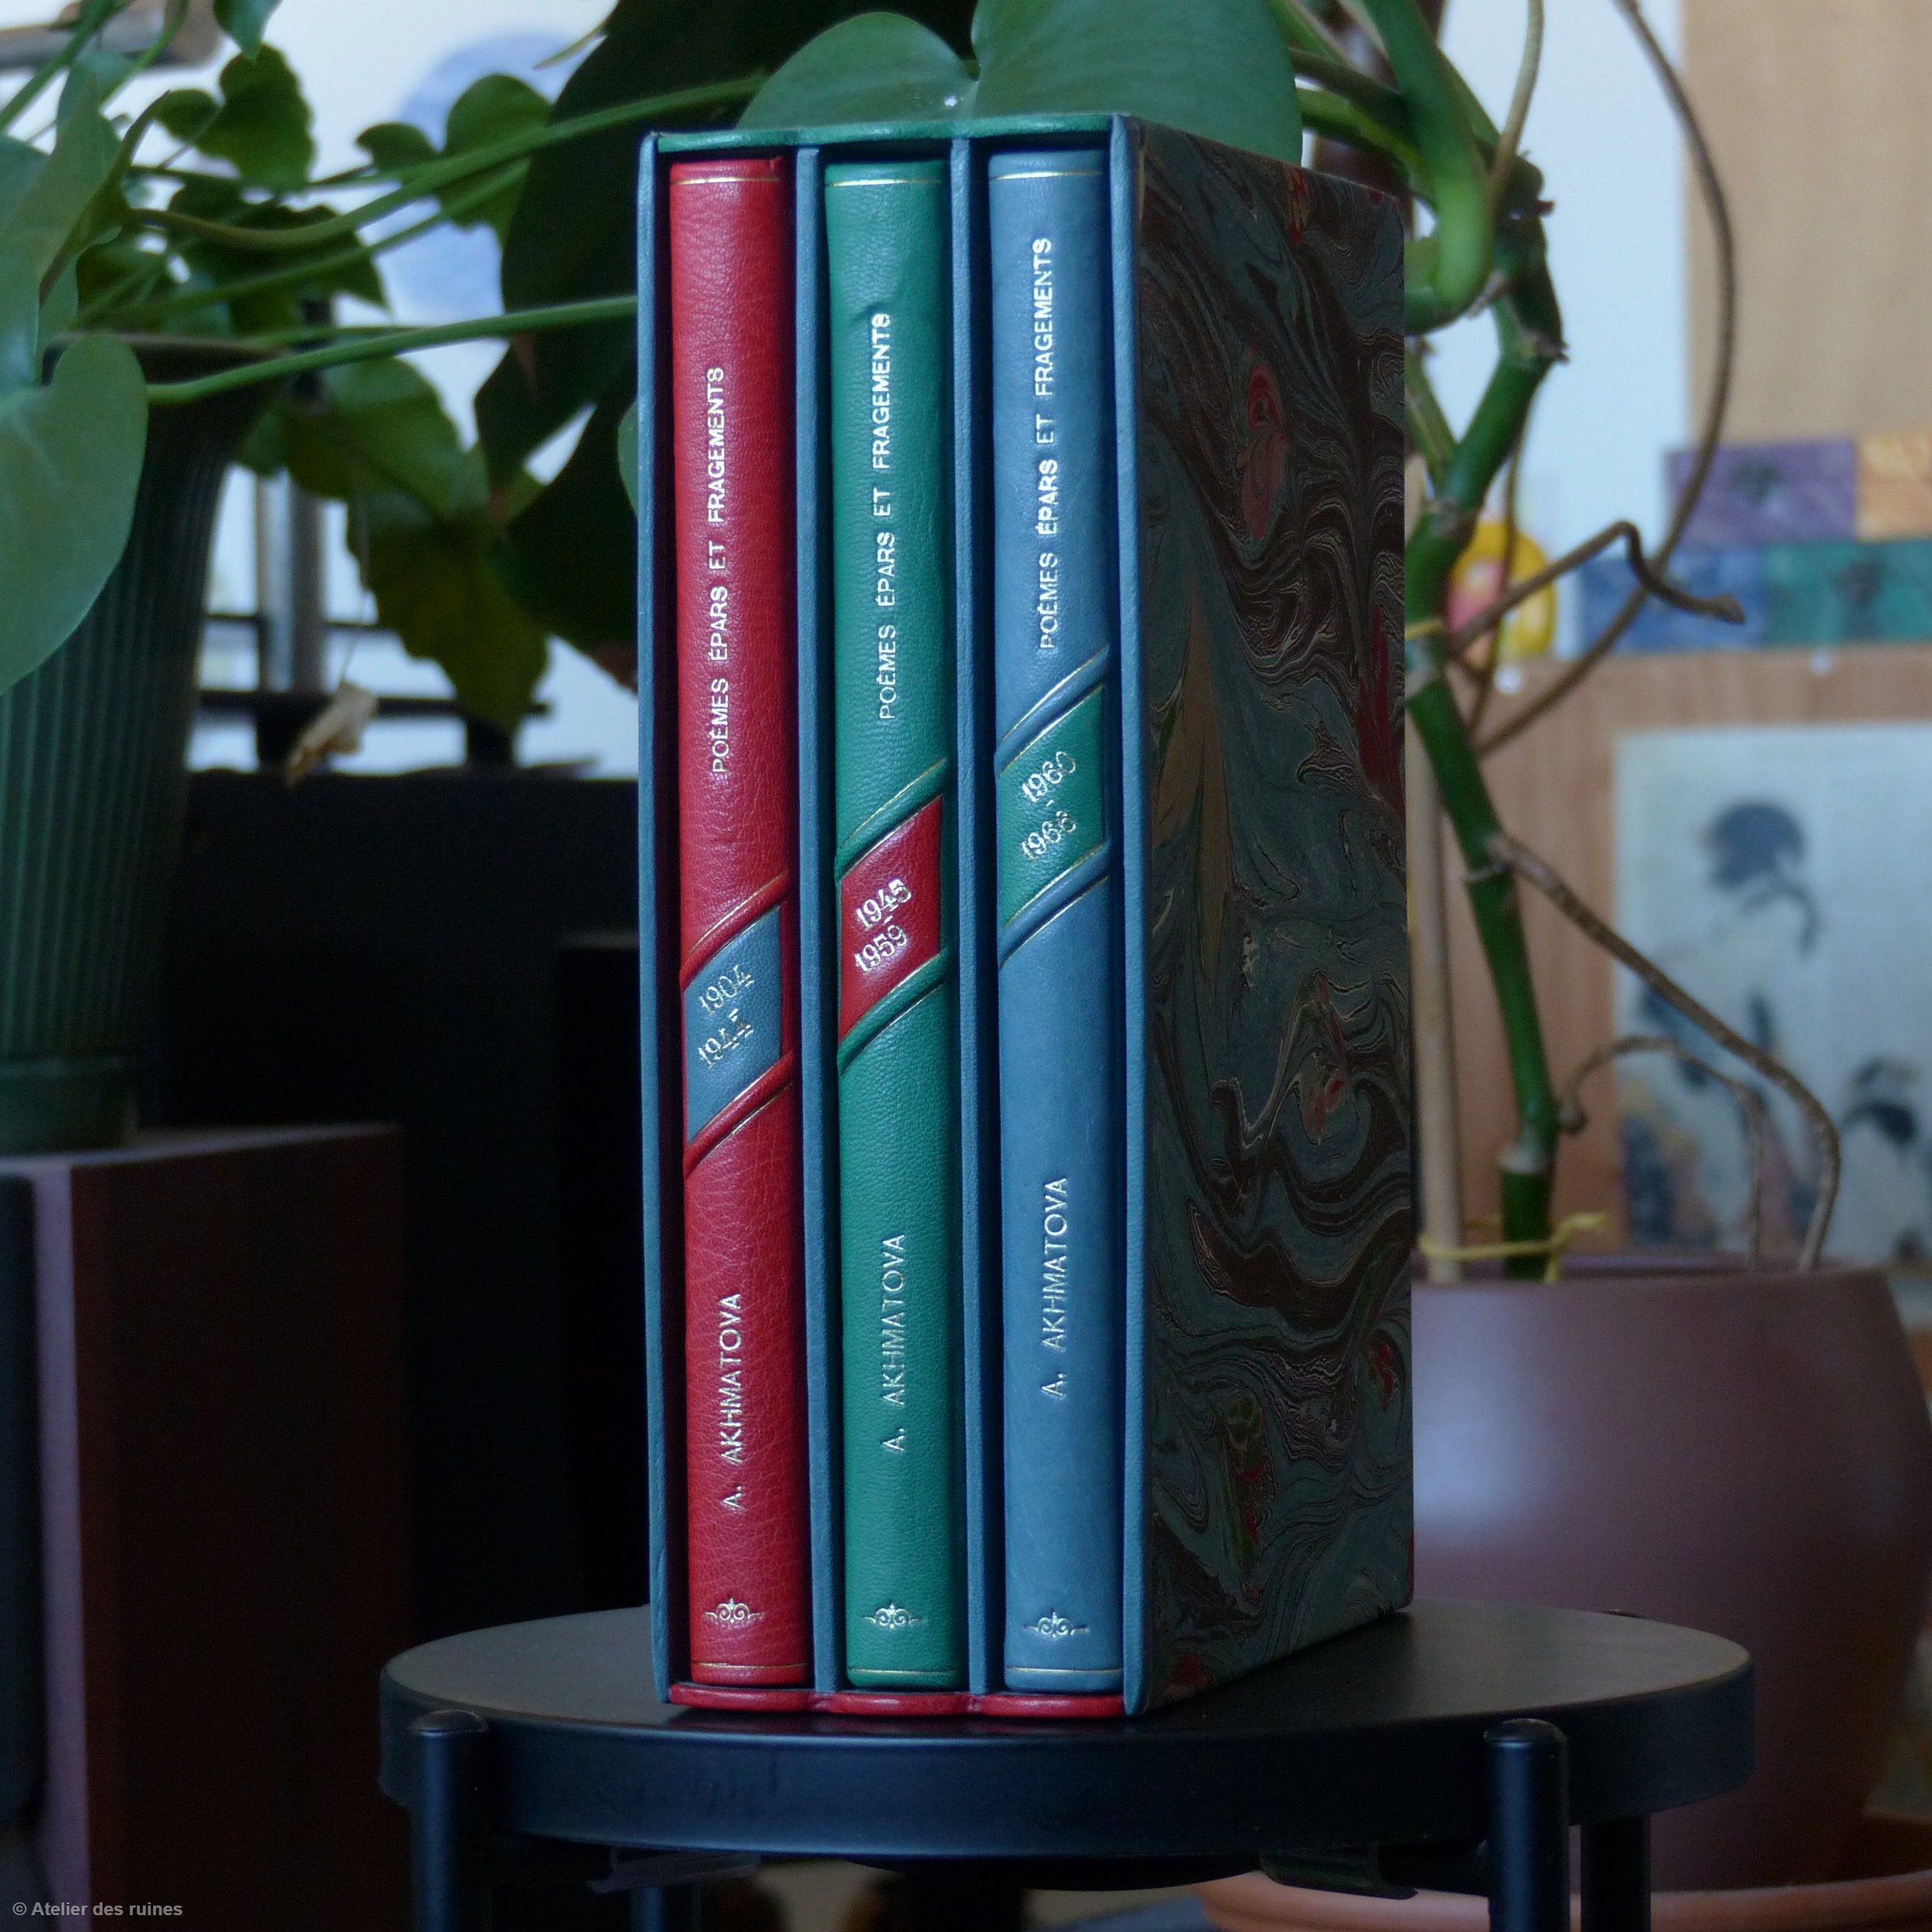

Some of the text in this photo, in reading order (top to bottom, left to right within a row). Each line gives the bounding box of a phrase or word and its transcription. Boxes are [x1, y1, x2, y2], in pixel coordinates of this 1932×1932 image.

[1032, 238, 1053, 396] FRAGEMENTS
[871, 313, 890, 469] FRAGEMENTS
[1036, 413, 1054, 444] ET
[706, 367, 726, 523] FRAGEMENTS
[873, 486, 890, 517] ET
[1035, 459, 1058, 535] ÉPARS
[709, 540, 726, 570] ET
[875, 532, 896, 607] ÉPARS
[708, 585, 728, 662] ÉPARS
[1022, 751, 1076, 802] 1960
[854, 878, 913, 929] 1945
[854, 923, 909, 974] 1959
[698, 964, 755, 1015] 1904
[1041, 1177, 1068, 1400] A. AKHMATOVA
[882, 1234, 905, 1451] A. AKHMATOVA
[719, 1294, 743, 1510] A. AKHMATOVA
